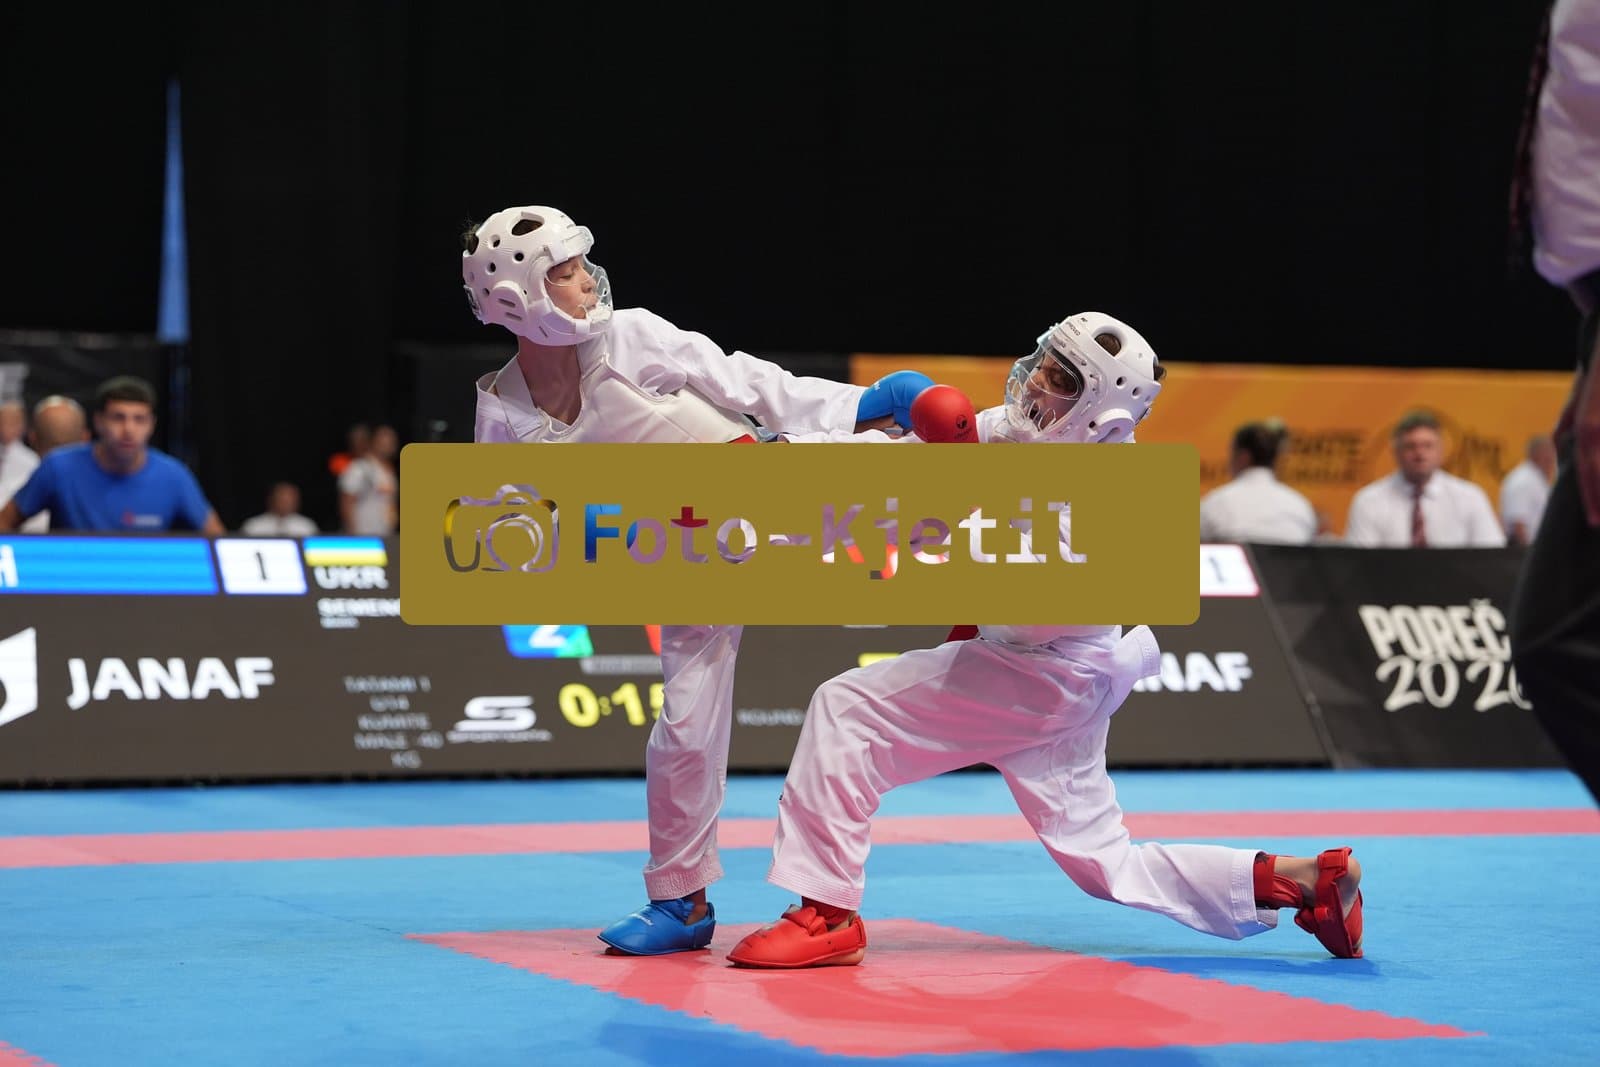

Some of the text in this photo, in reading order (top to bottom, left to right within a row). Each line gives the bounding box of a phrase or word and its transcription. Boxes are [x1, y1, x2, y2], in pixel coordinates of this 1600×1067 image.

[313, 566, 389, 590] UKR
[317, 598, 400, 617] SEMEN
[1358, 598, 1513, 662] POREČ
[66, 657, 275, 711] JANAF
[1132, 651, 1253, 693] NAF
